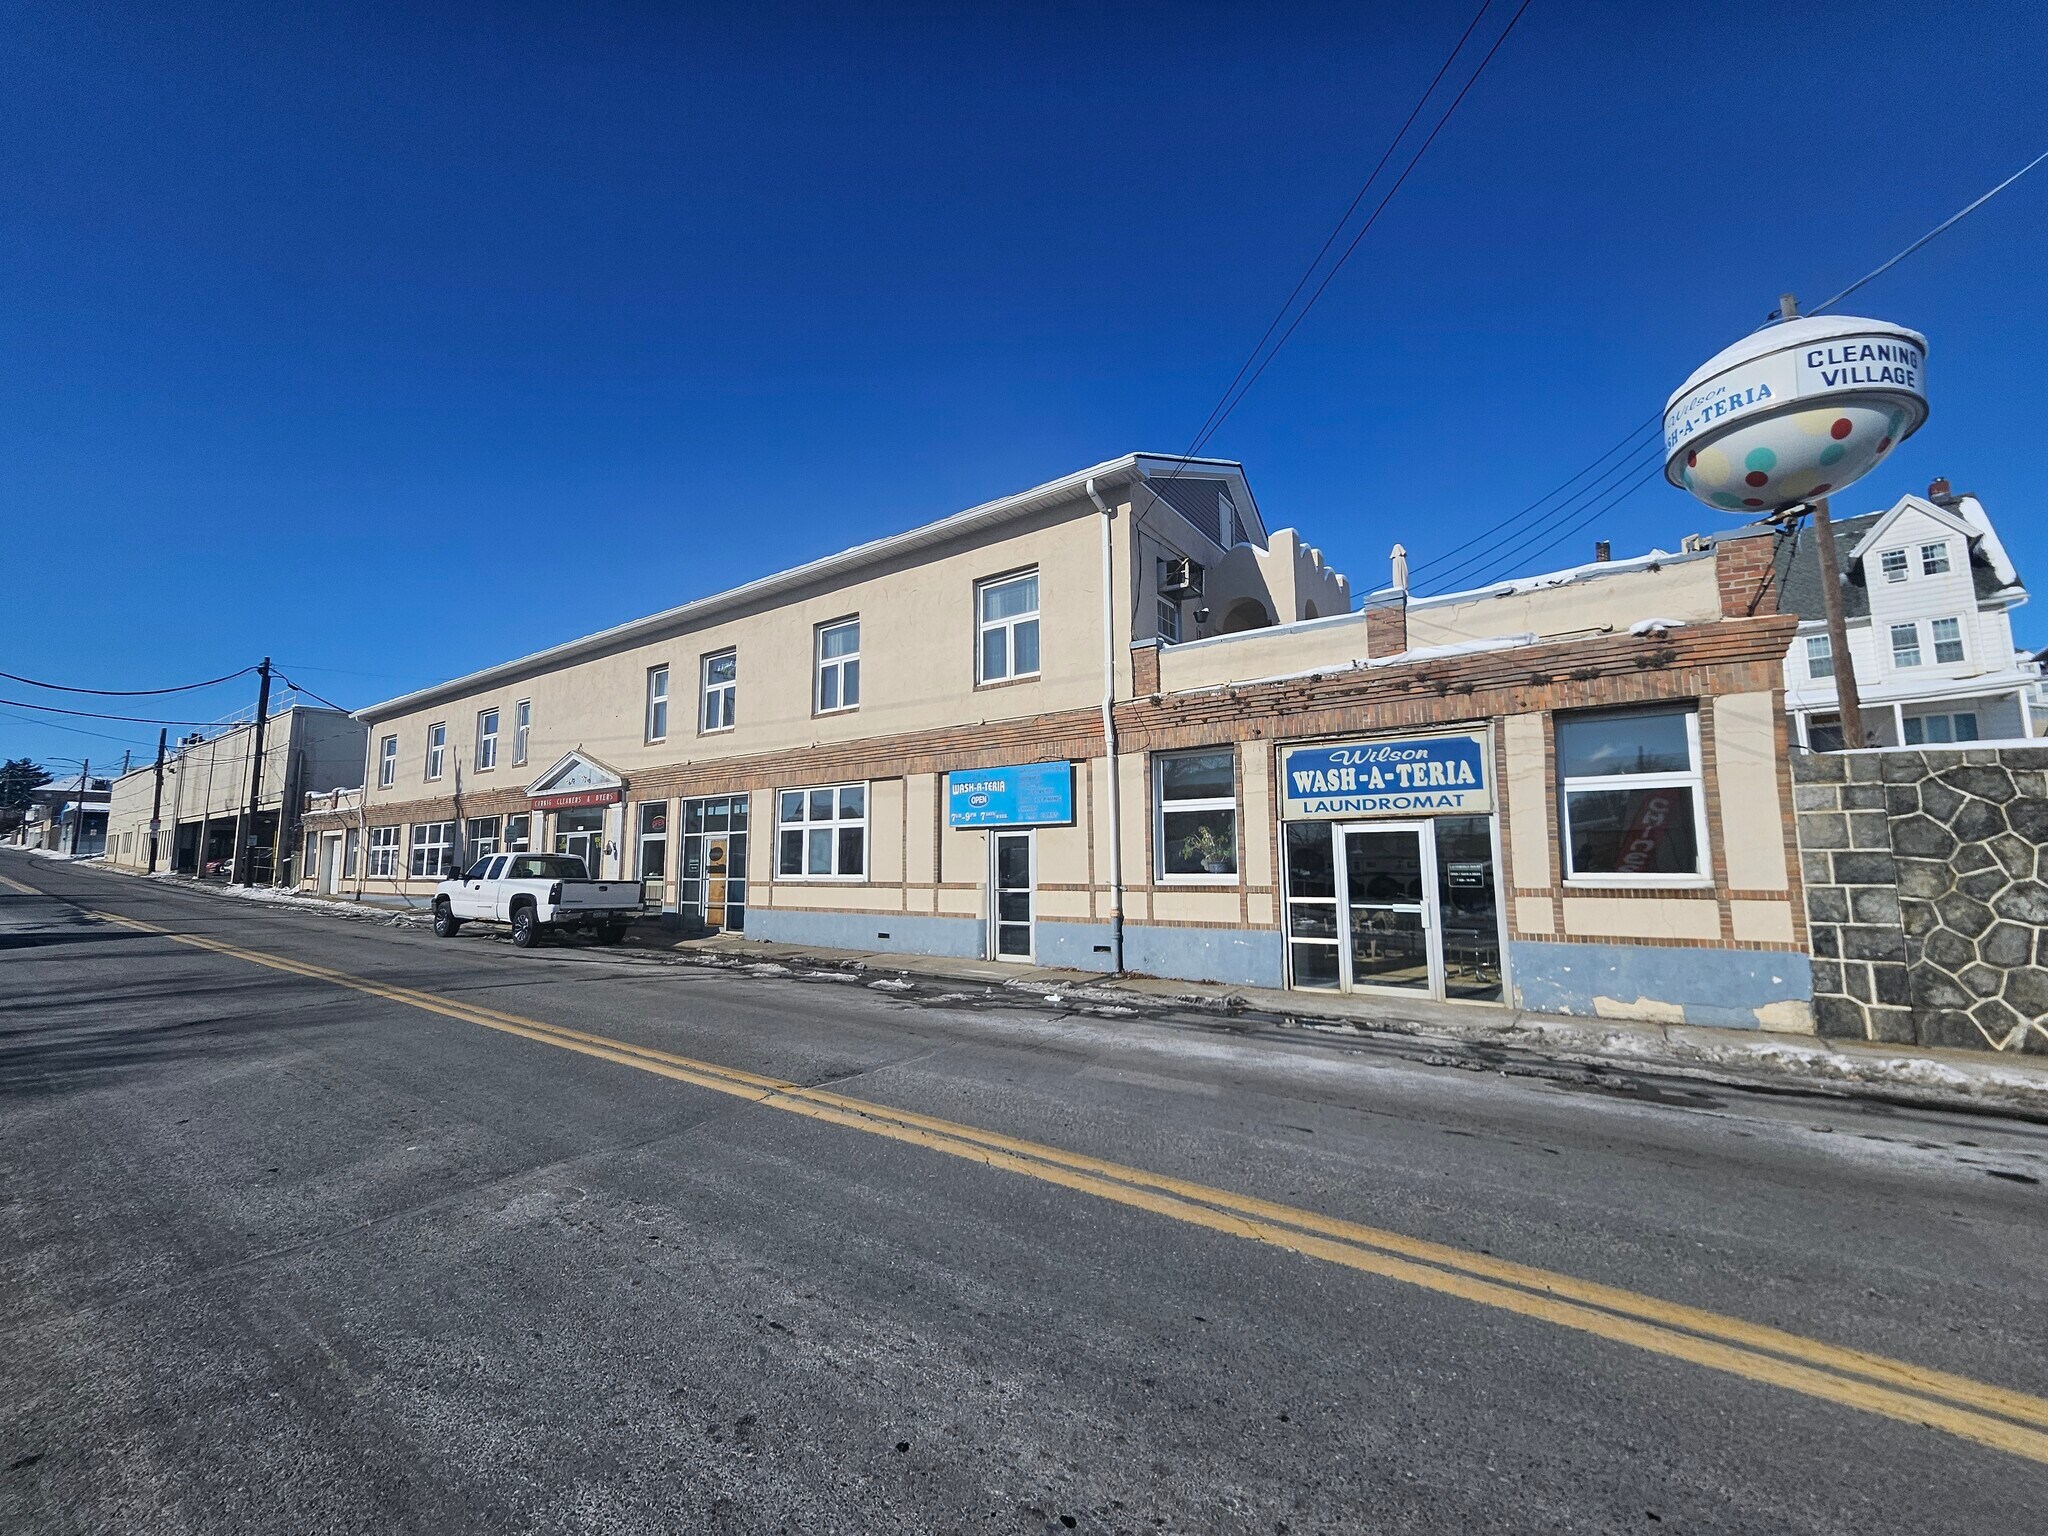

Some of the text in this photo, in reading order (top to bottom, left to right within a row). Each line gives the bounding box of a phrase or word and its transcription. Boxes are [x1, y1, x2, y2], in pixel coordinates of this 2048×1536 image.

[1807, 344, 1918, 370] CLEANING
[1821, 366, 1915, 388] VILLAGE
[1667, 384, 1772, 450] SH-A-TERIA
[1329, 747, 1428, 765] Wilson
[1293, 760, 1475, 794] WASH-A-TERIA
[952, 781, 1005, 795] WASH-A-TERIA
[557, 796, 581, 805] CLEANERS
[596, 793, 613, 801] DYERS
[971, 795, 987, 804] OPEN
[1304, 794, 1464, 813] LAUNDROMAT
